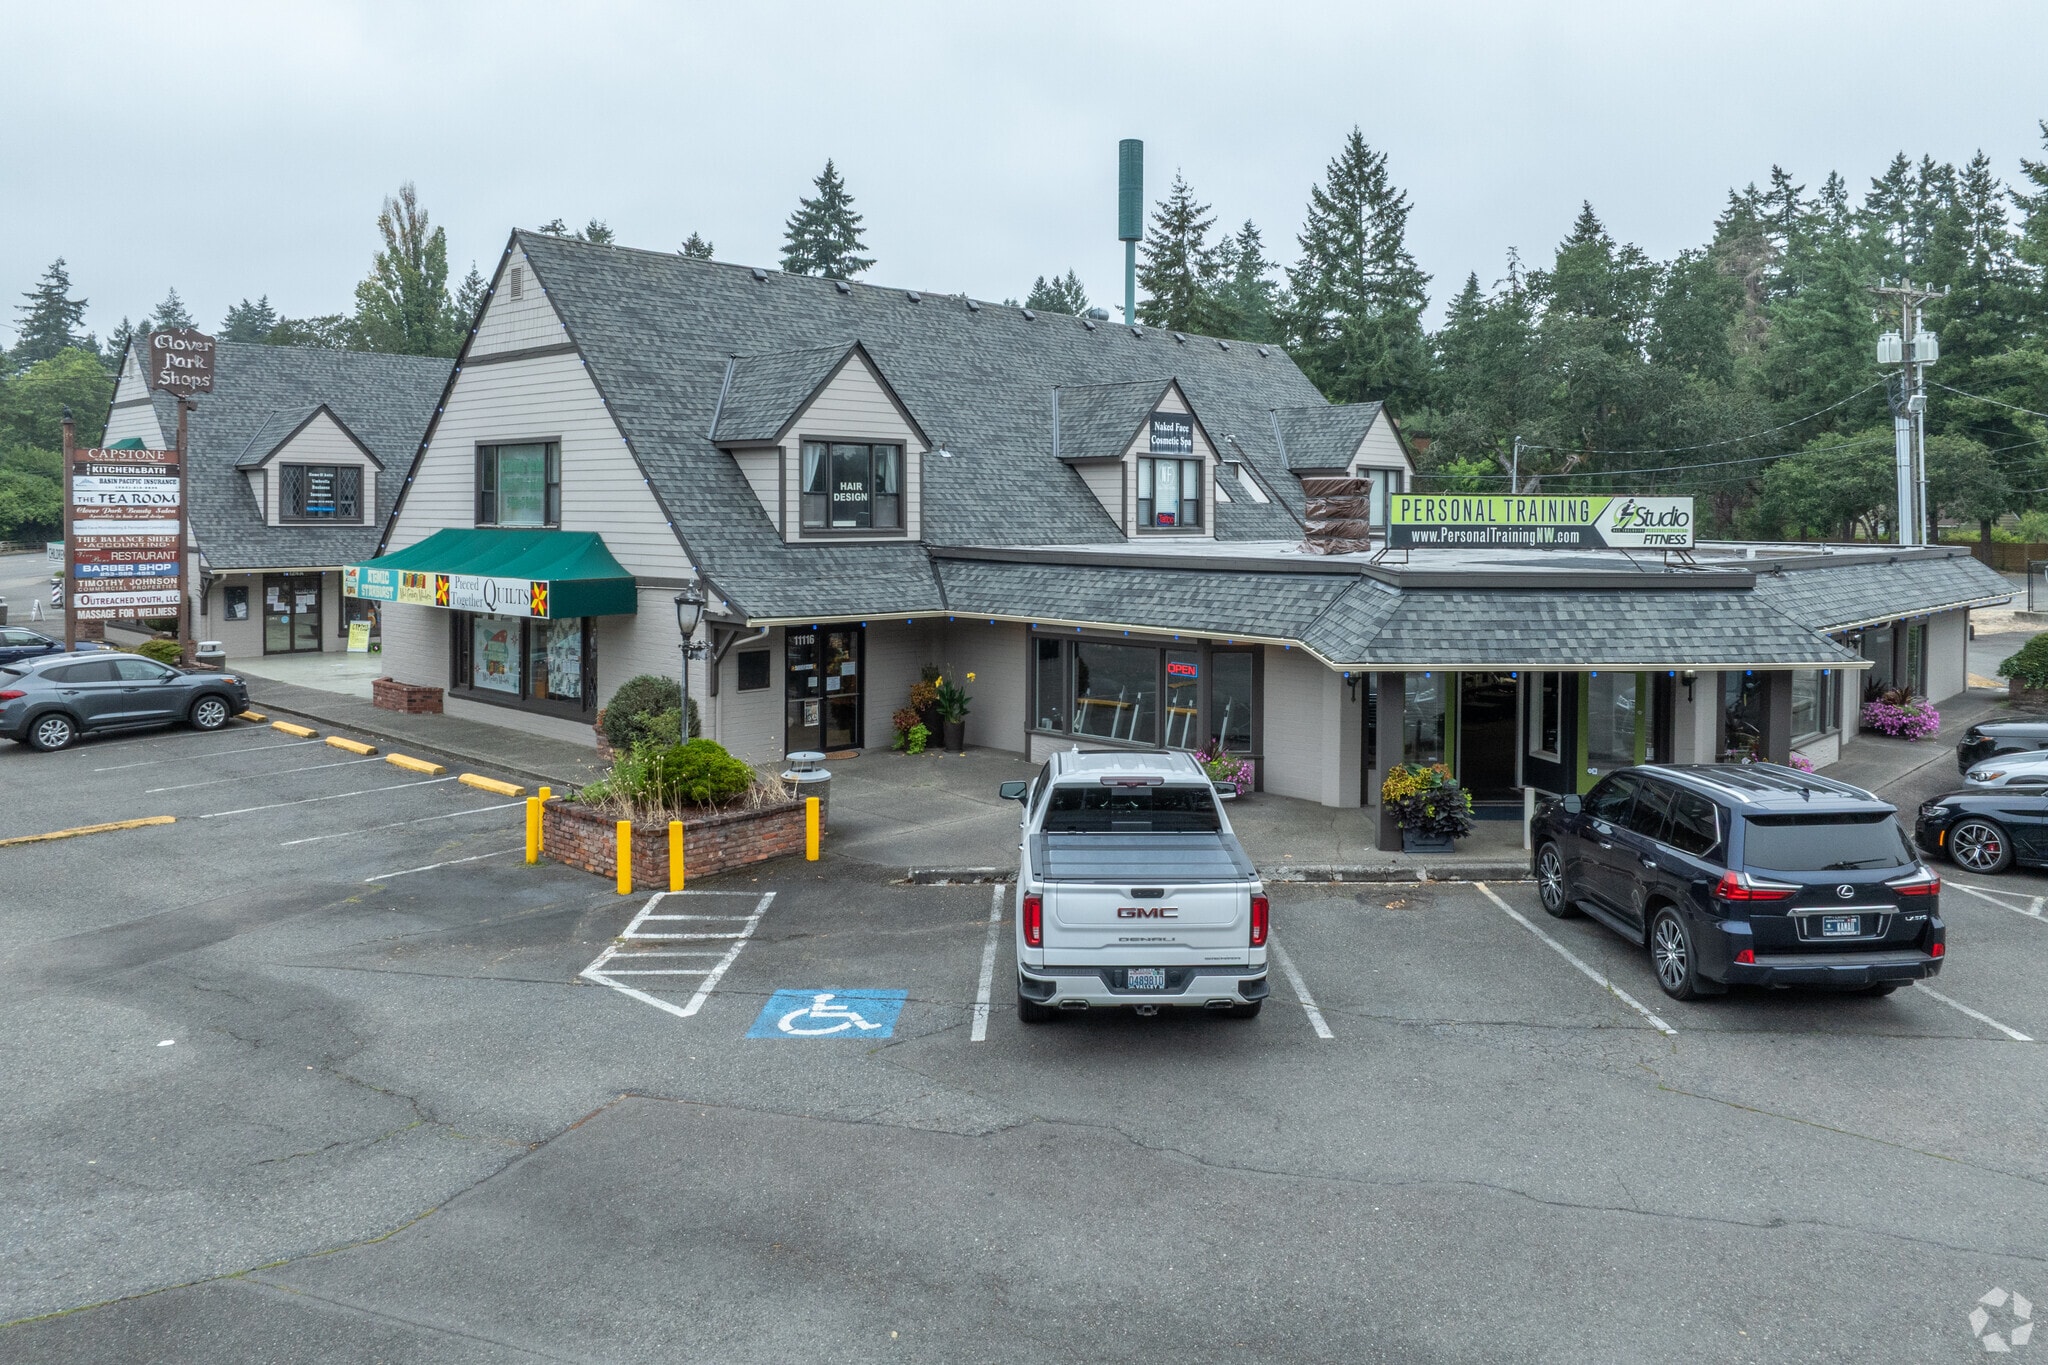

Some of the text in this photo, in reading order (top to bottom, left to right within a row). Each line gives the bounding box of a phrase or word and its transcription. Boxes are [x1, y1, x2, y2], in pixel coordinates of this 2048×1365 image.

[154, 335, 213, 351] Clover
[162, 353, 208, 370] Park
[158, 370, 212, 390] Shops
[1154, 421, 1190, 433] Naked Face
[1151, 435, 1192, 449] Cosmetic Spa
[88, 448, 166, 460] CAPSTONE
[840, 482, 862, 491] HAIR
[98, 493, 128, 504] TEA
[132, 493, 177, 504] ROOM
[833, 492, 868, 502] DESIGN
[76, 506, 100, 514] Clover
[102, 507, 123, 515] Park
[126, 507, 152, 515] Beauty
[1401, 498, 1590, 523] PERSONAL TRAINING
[1412, 527, 1579, 546] www.PersonalTrainingNW.com
[1643, 534, 1687, 545] FITNESS
[111, 551, 176, 561] RESTAURANT
[78, 578, 177, 587] TIMOTHY JOHNSON
[455, 576, 479, 591] Pieced
[136, 597, 164, 605] YOUTH,
[451, 591, 483, 609] Together
[484, 578, 529, 612] QUILTS
[77, 607, 177, 620] MASSAGE FOR WELLNESS
[794, 634, 815, 646] 11116
[1168, 663, 1196, 676] OPEN
[1117, 907, 1178, 918] GMC
